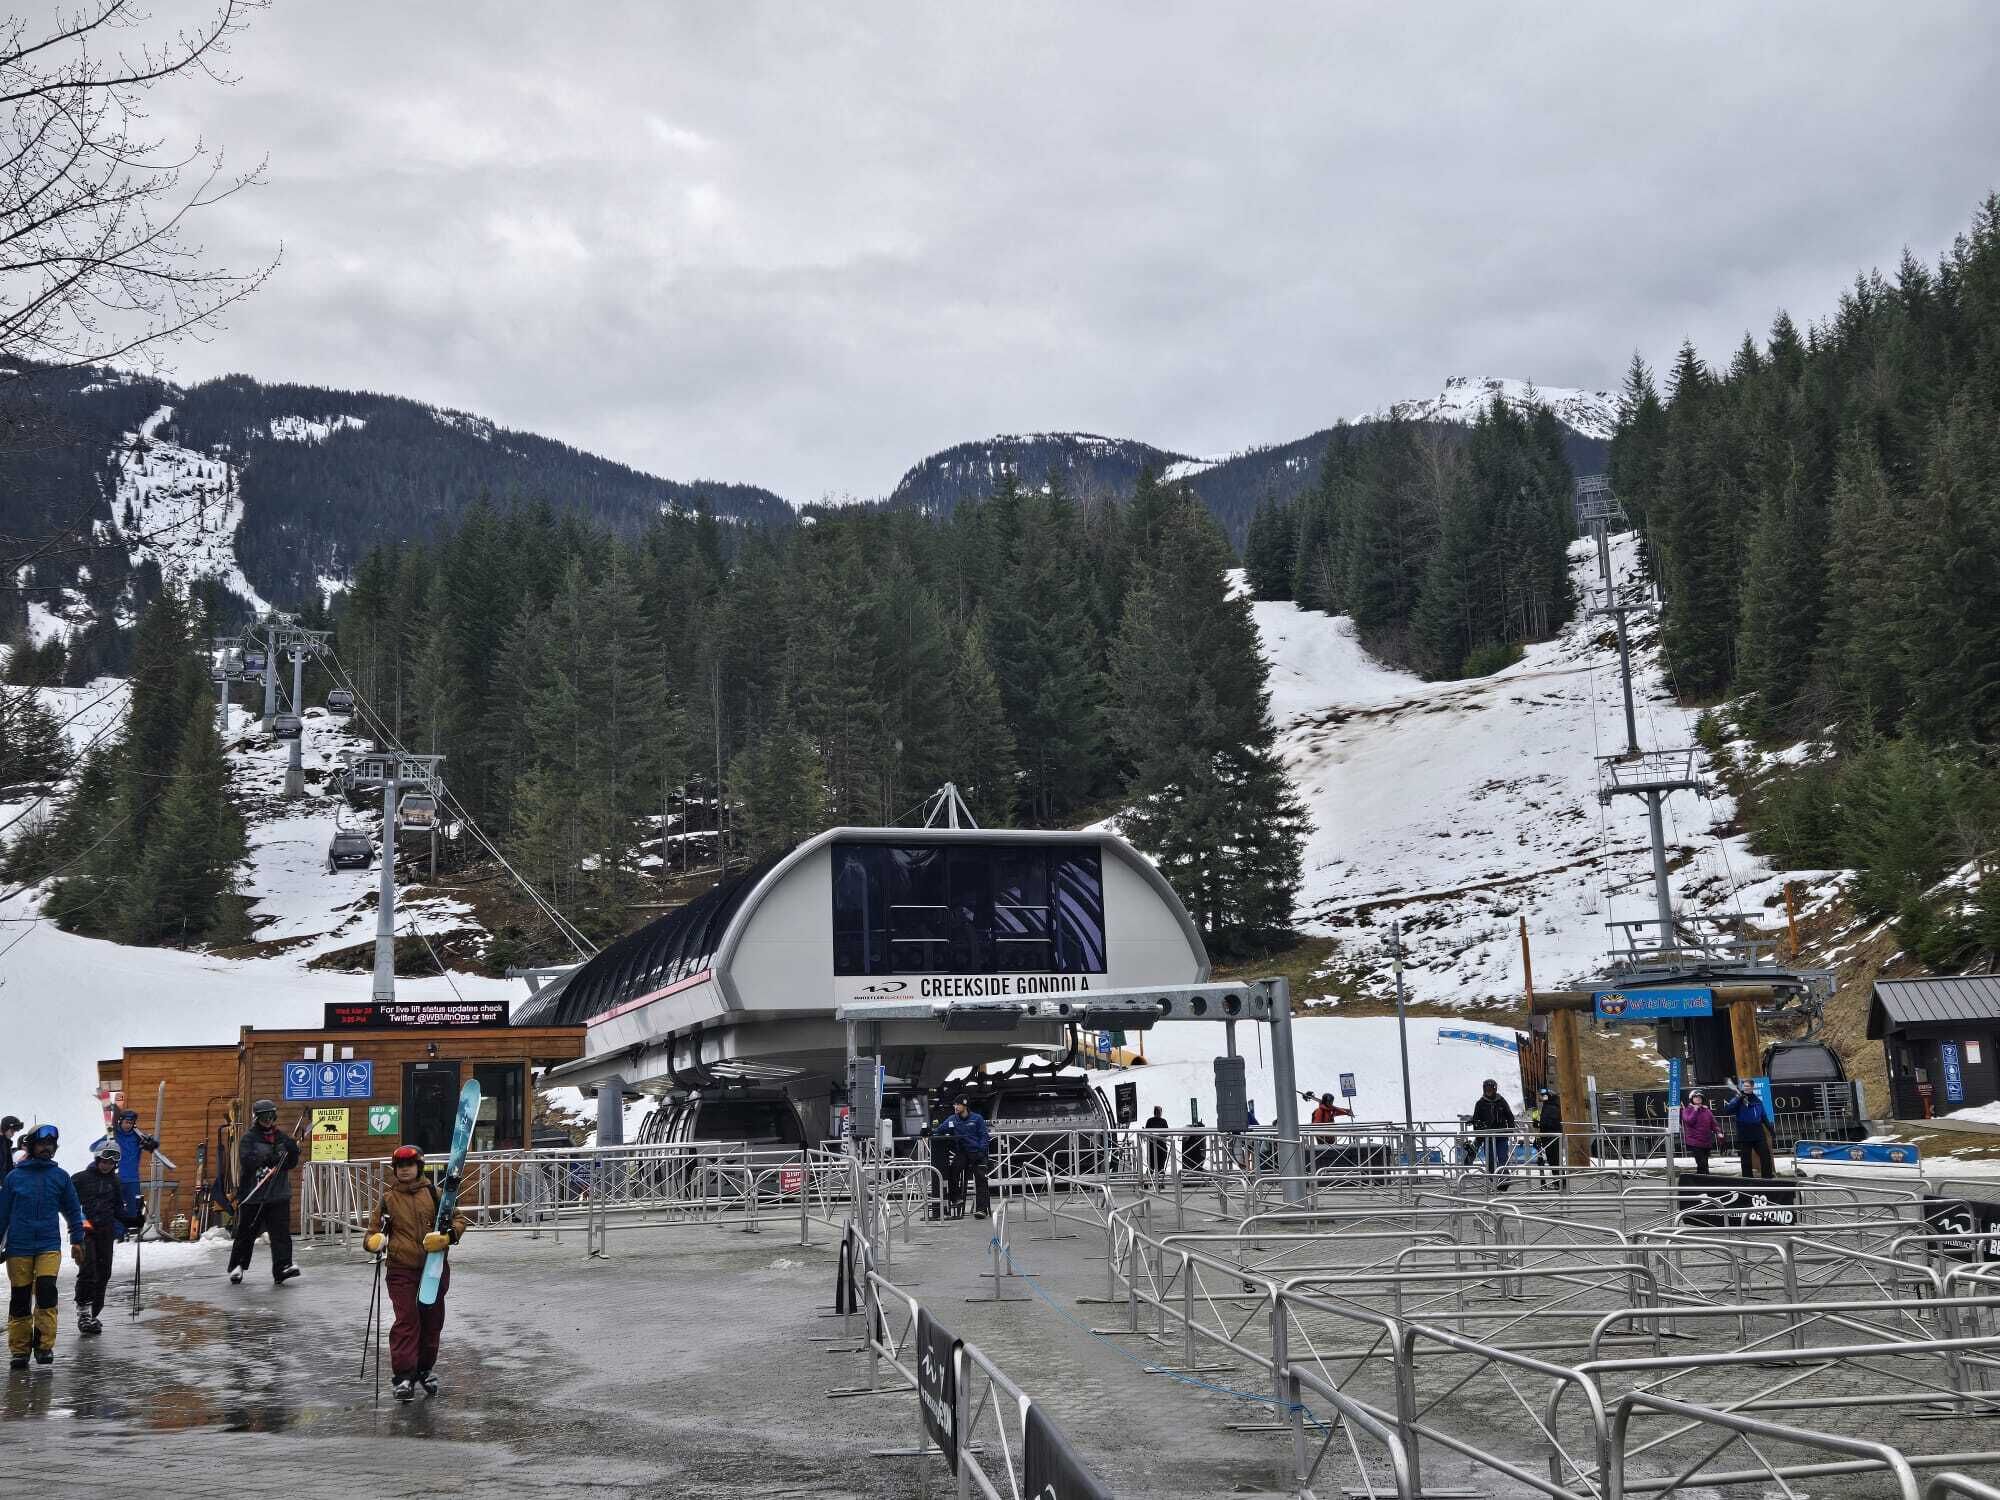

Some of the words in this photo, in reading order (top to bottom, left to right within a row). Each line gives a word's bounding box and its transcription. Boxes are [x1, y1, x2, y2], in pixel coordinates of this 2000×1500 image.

[921, 977, 1010, 997] CREEKSIDE
[1017, 976, 1089, 994] GONDOLA
[380, 1005, 394, 1014] For
[395, 1005, 409, 1013] live
[411, 1005, 420, 1013] lift
[422, 1004, 446, 1013] status
[447, 1004, 478, 1013] updates
[480, 1003, 502, 1012] check
[389, 1013, 415, 1022] Twitter
[1751, 1194, 1768, 1208] GO
[1749, 1210, 1794, 1224] BEYOND
